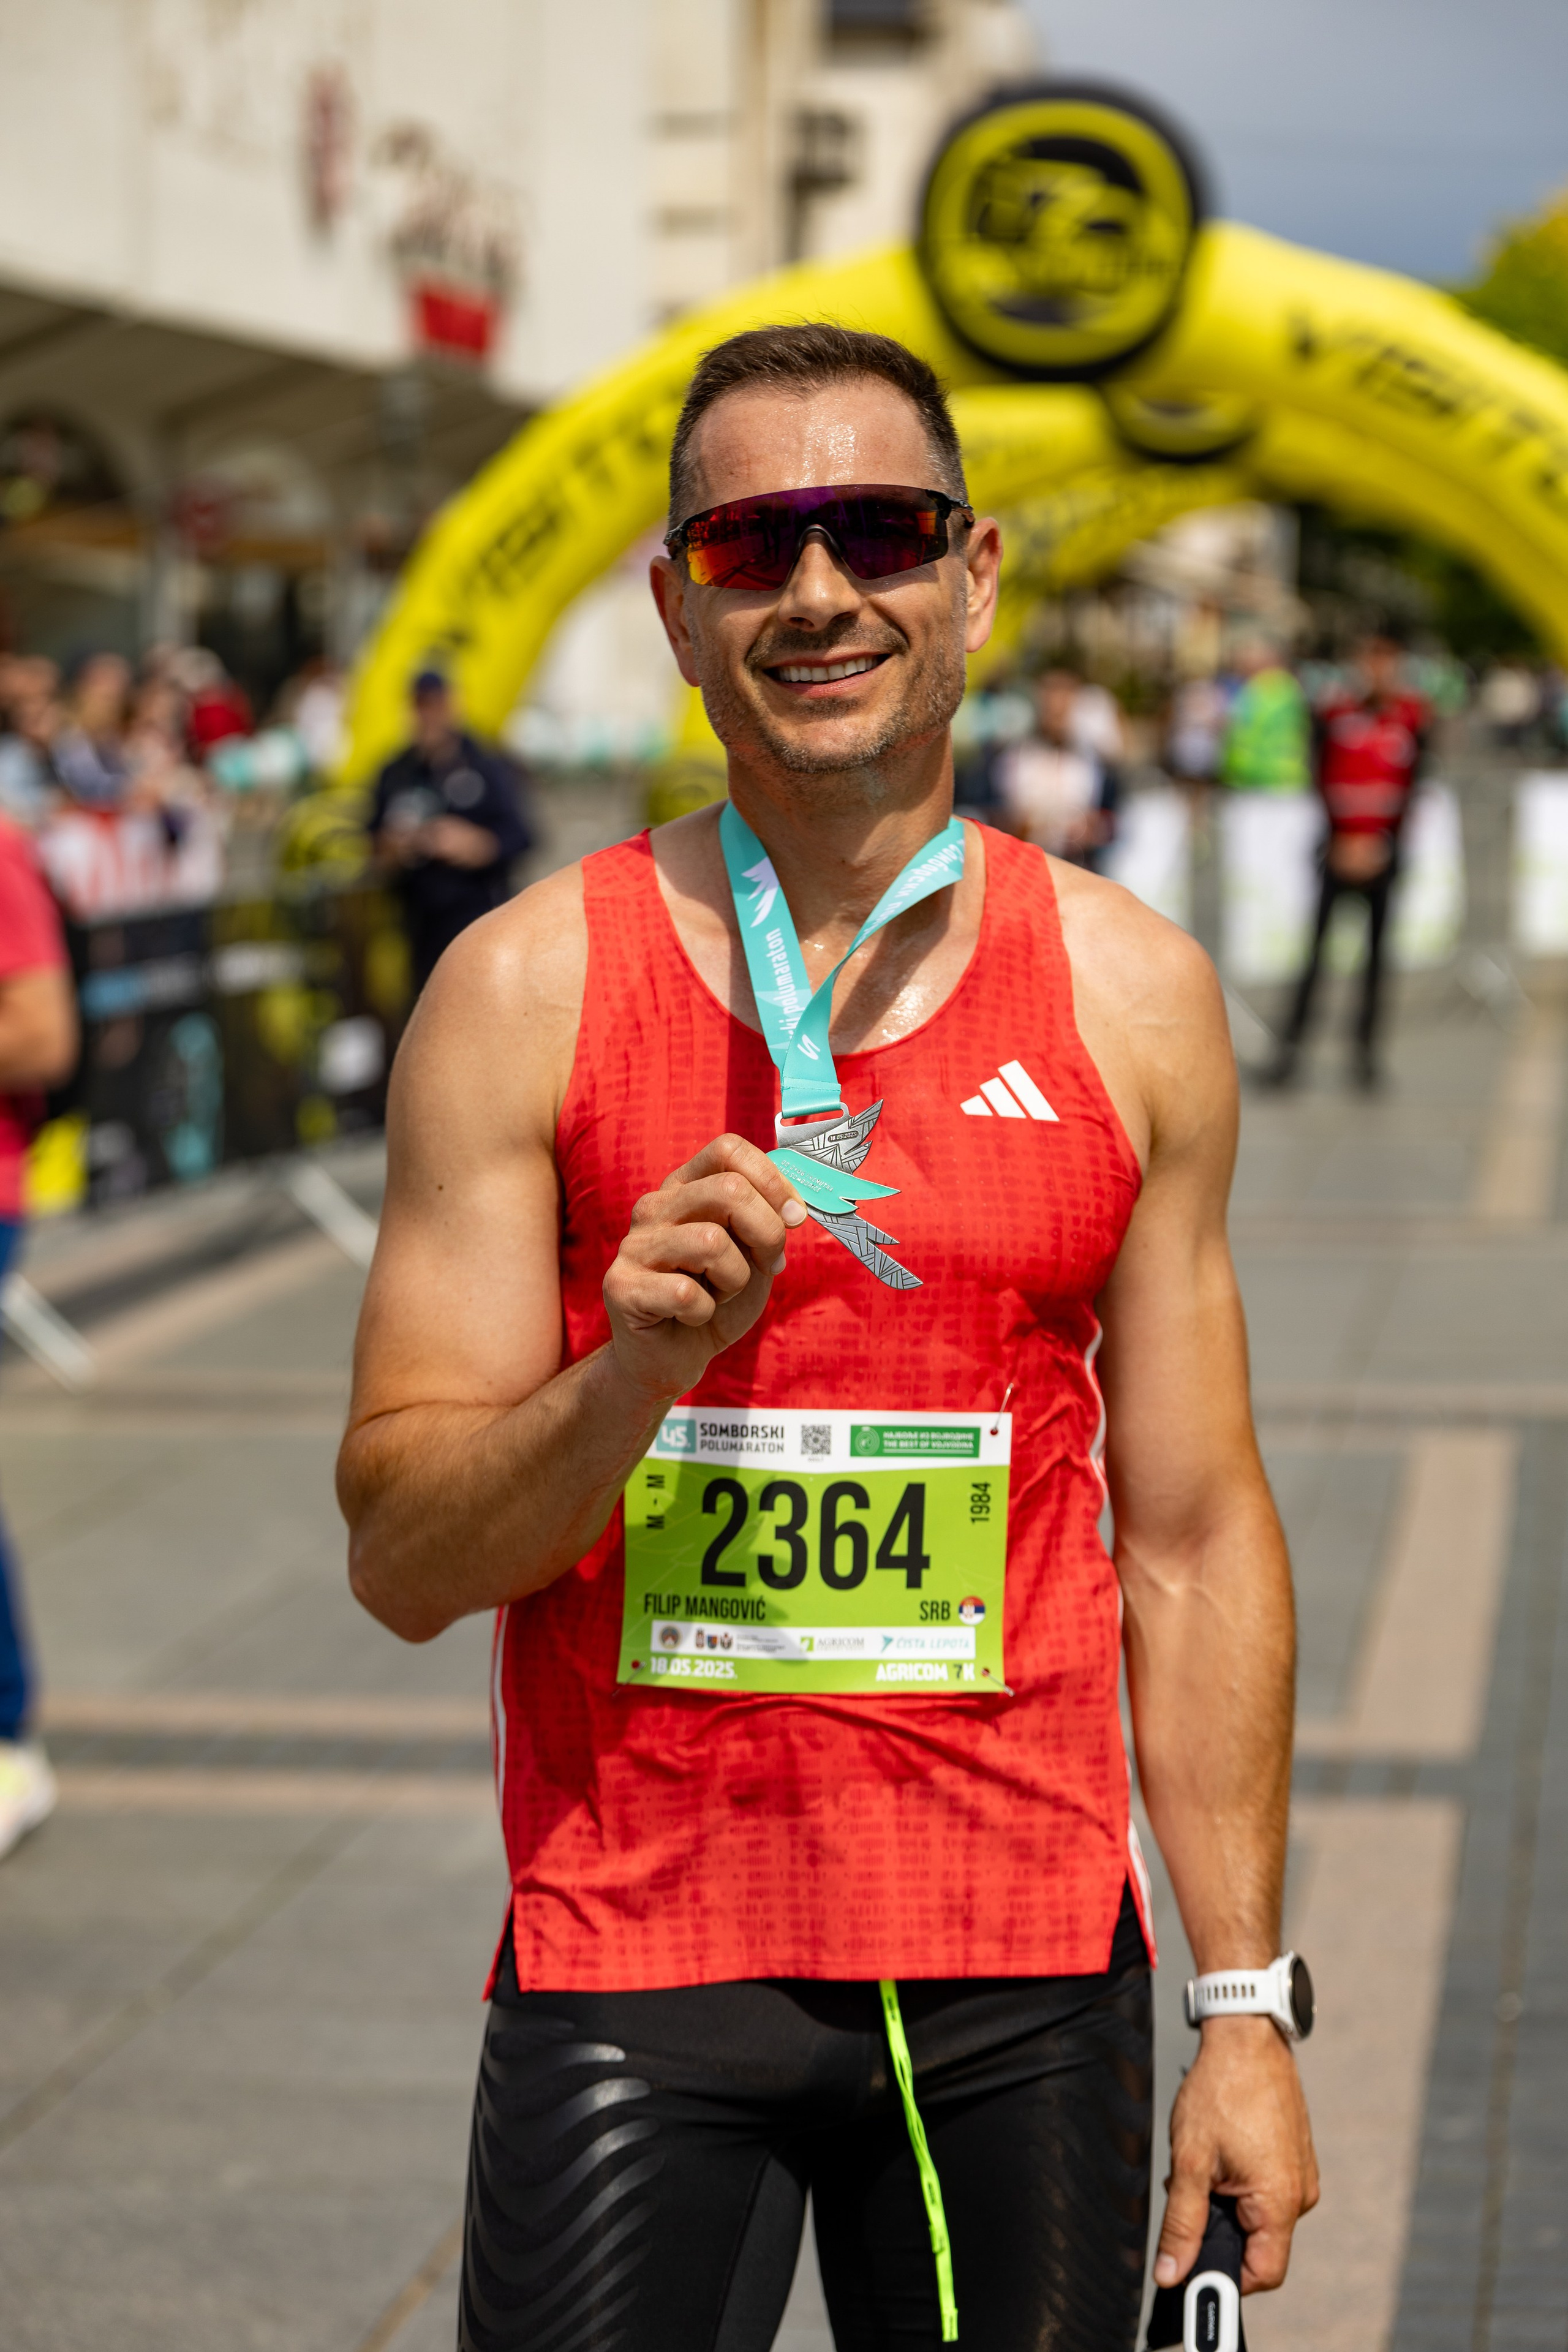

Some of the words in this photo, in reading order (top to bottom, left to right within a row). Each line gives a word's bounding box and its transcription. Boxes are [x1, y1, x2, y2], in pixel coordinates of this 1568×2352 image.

[700, 1423, 785, 1439] SOMBORSKI
[700, 1439, 785, 1453] POLUMARATON
[971, 1482, 991, 1524] 1984
[701, 1477, 931, 1591] 2364
[644, 1593, 681, 1615] FILIP
[685, 1595, 766, 1621] MANGOVIĆ
[919, 1600, 951, 1621] SRB
[930, 1637, 970, 1649] LEPOTA
[875, 1662, 949, 1682] AGRICOM
